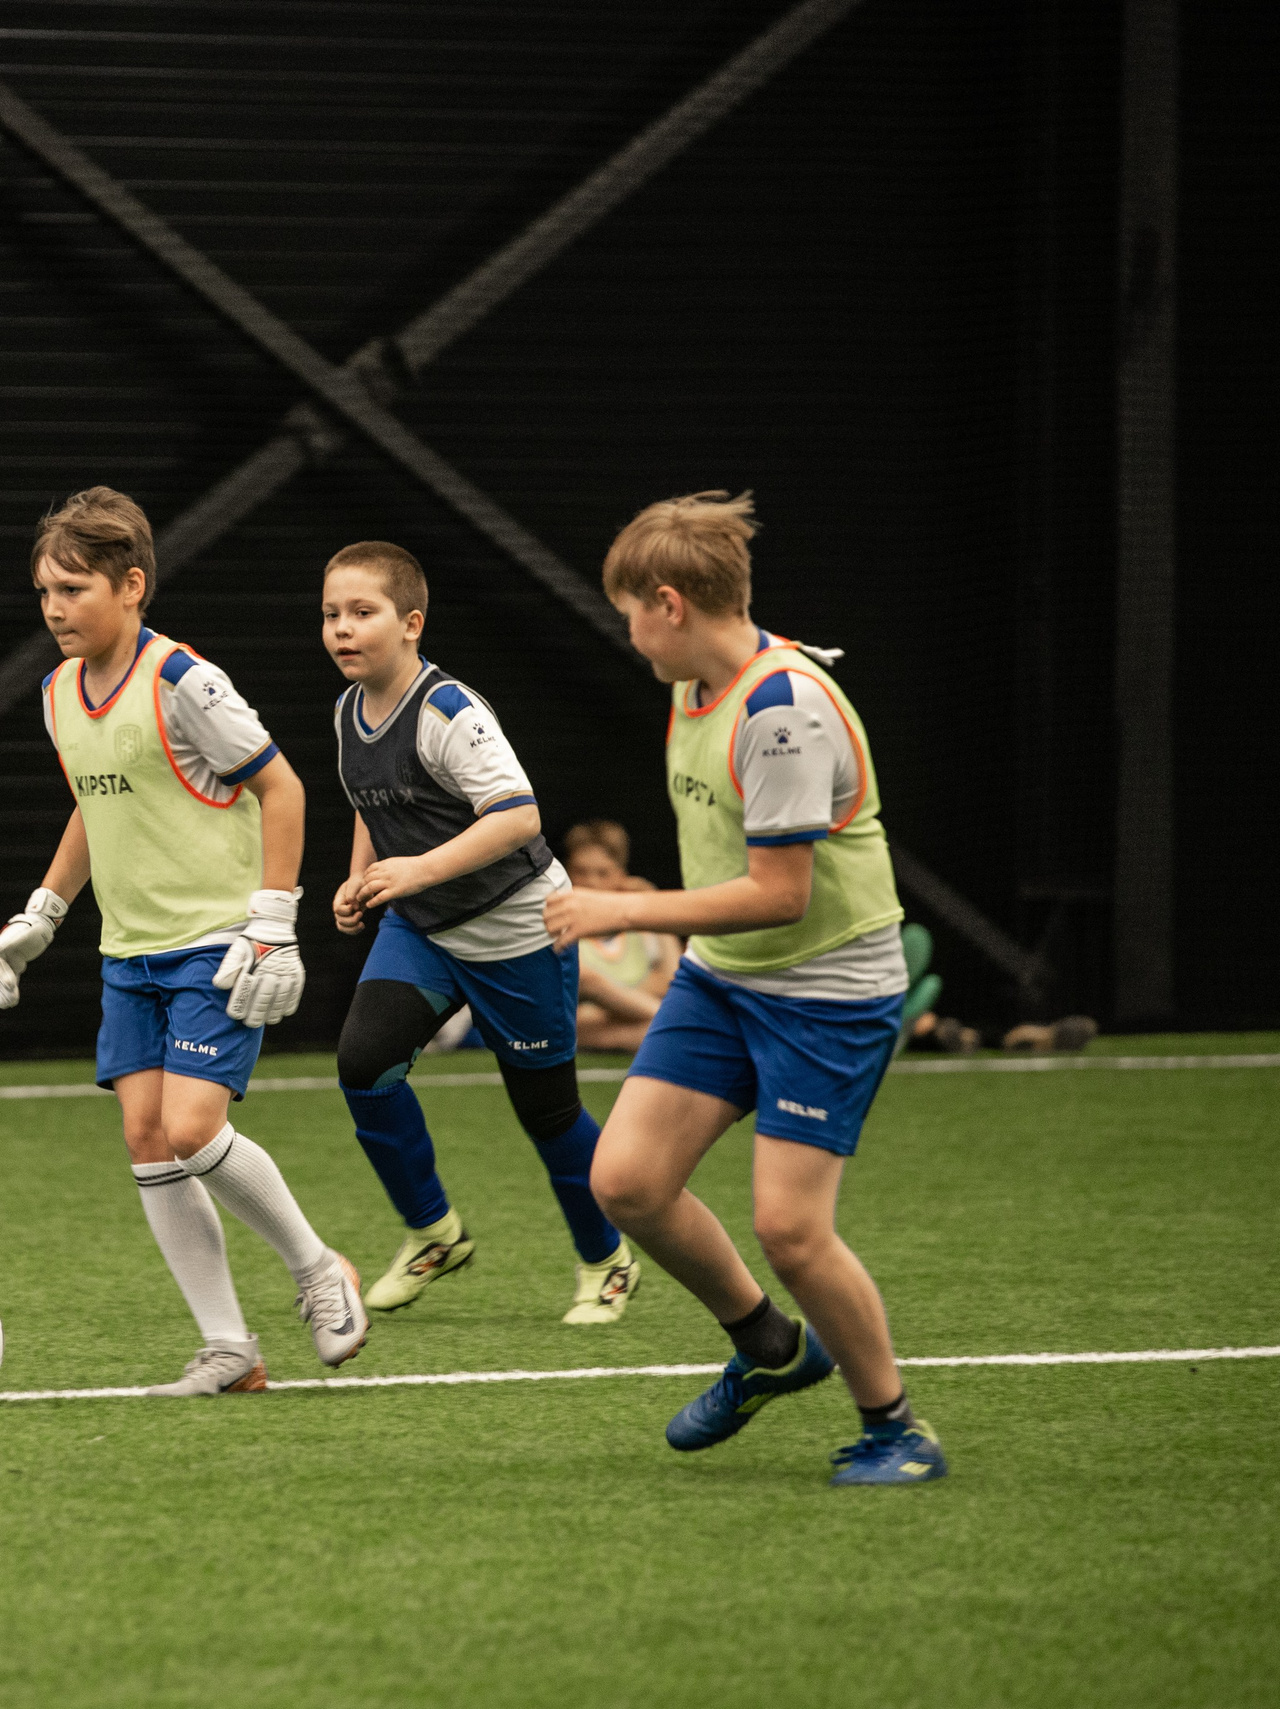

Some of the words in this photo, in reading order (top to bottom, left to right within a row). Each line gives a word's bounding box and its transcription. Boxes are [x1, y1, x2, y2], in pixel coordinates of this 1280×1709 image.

[762, 746, 801, 757] KELME
[75, 774, 134, 796] KIPSTA
[175, 1039, 218, 1056] KELME
